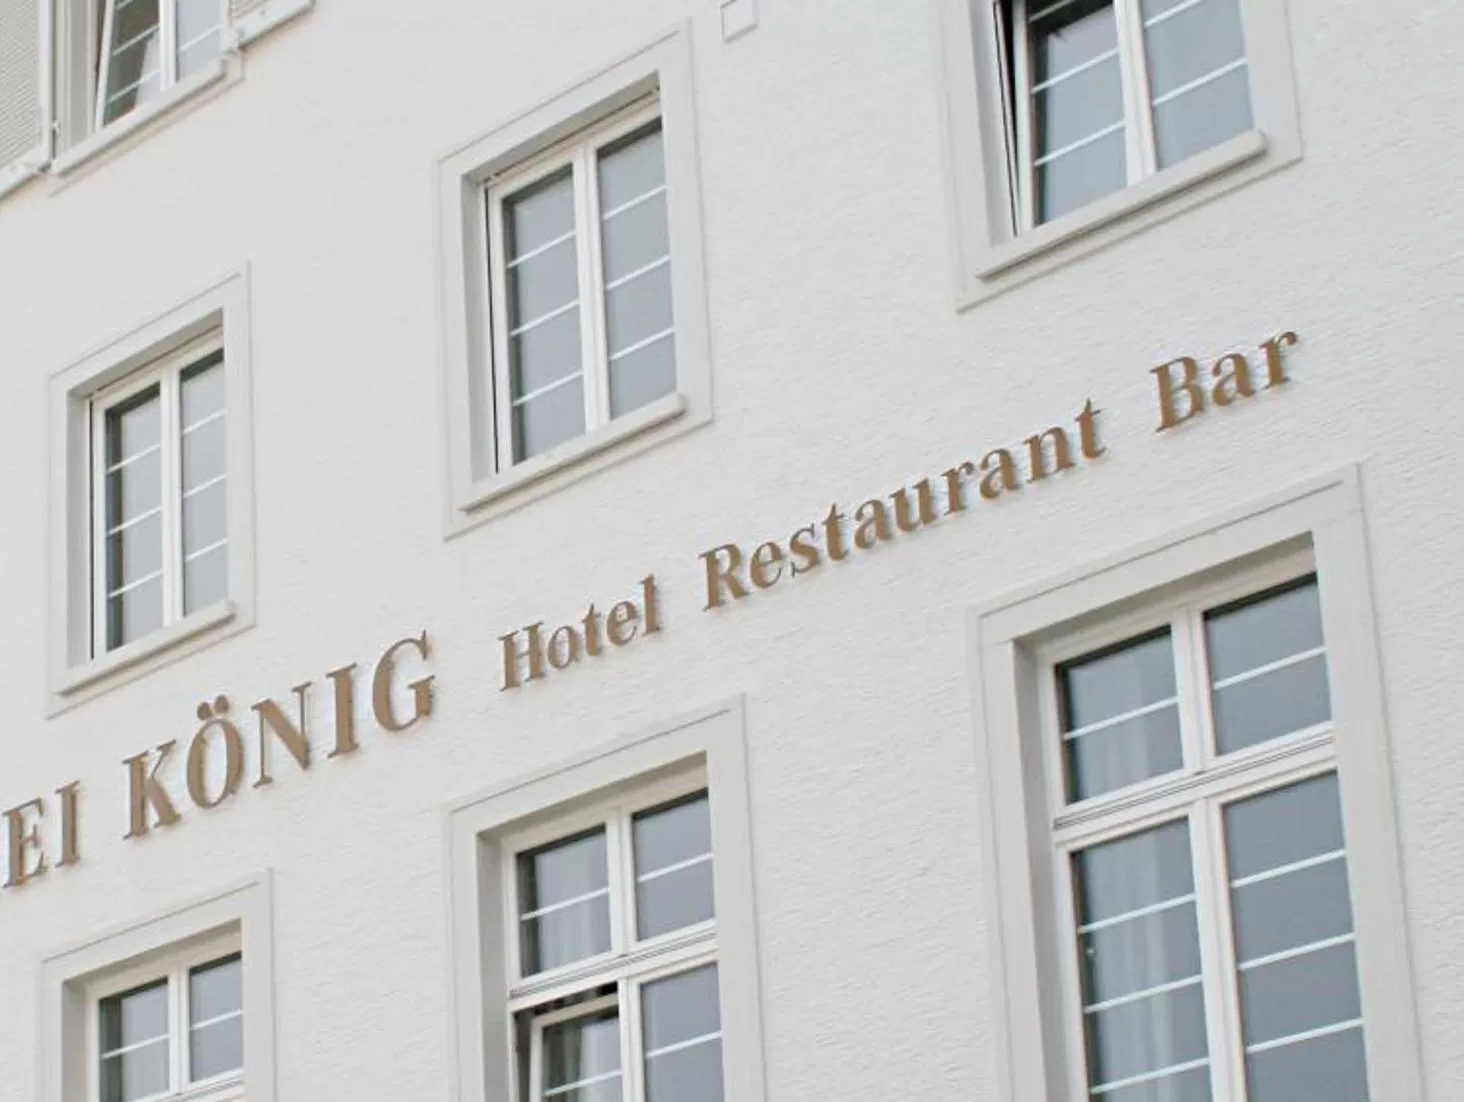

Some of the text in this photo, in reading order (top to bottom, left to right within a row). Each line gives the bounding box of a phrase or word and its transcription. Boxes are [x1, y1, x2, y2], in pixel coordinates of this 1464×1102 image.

[122, 629, 436, 841] KÖNIG
[498, 573, 663, 692] Hotel
[698, 397, 1107, 613] Restaurant
[1149, 331, 1299, 432] Bar
